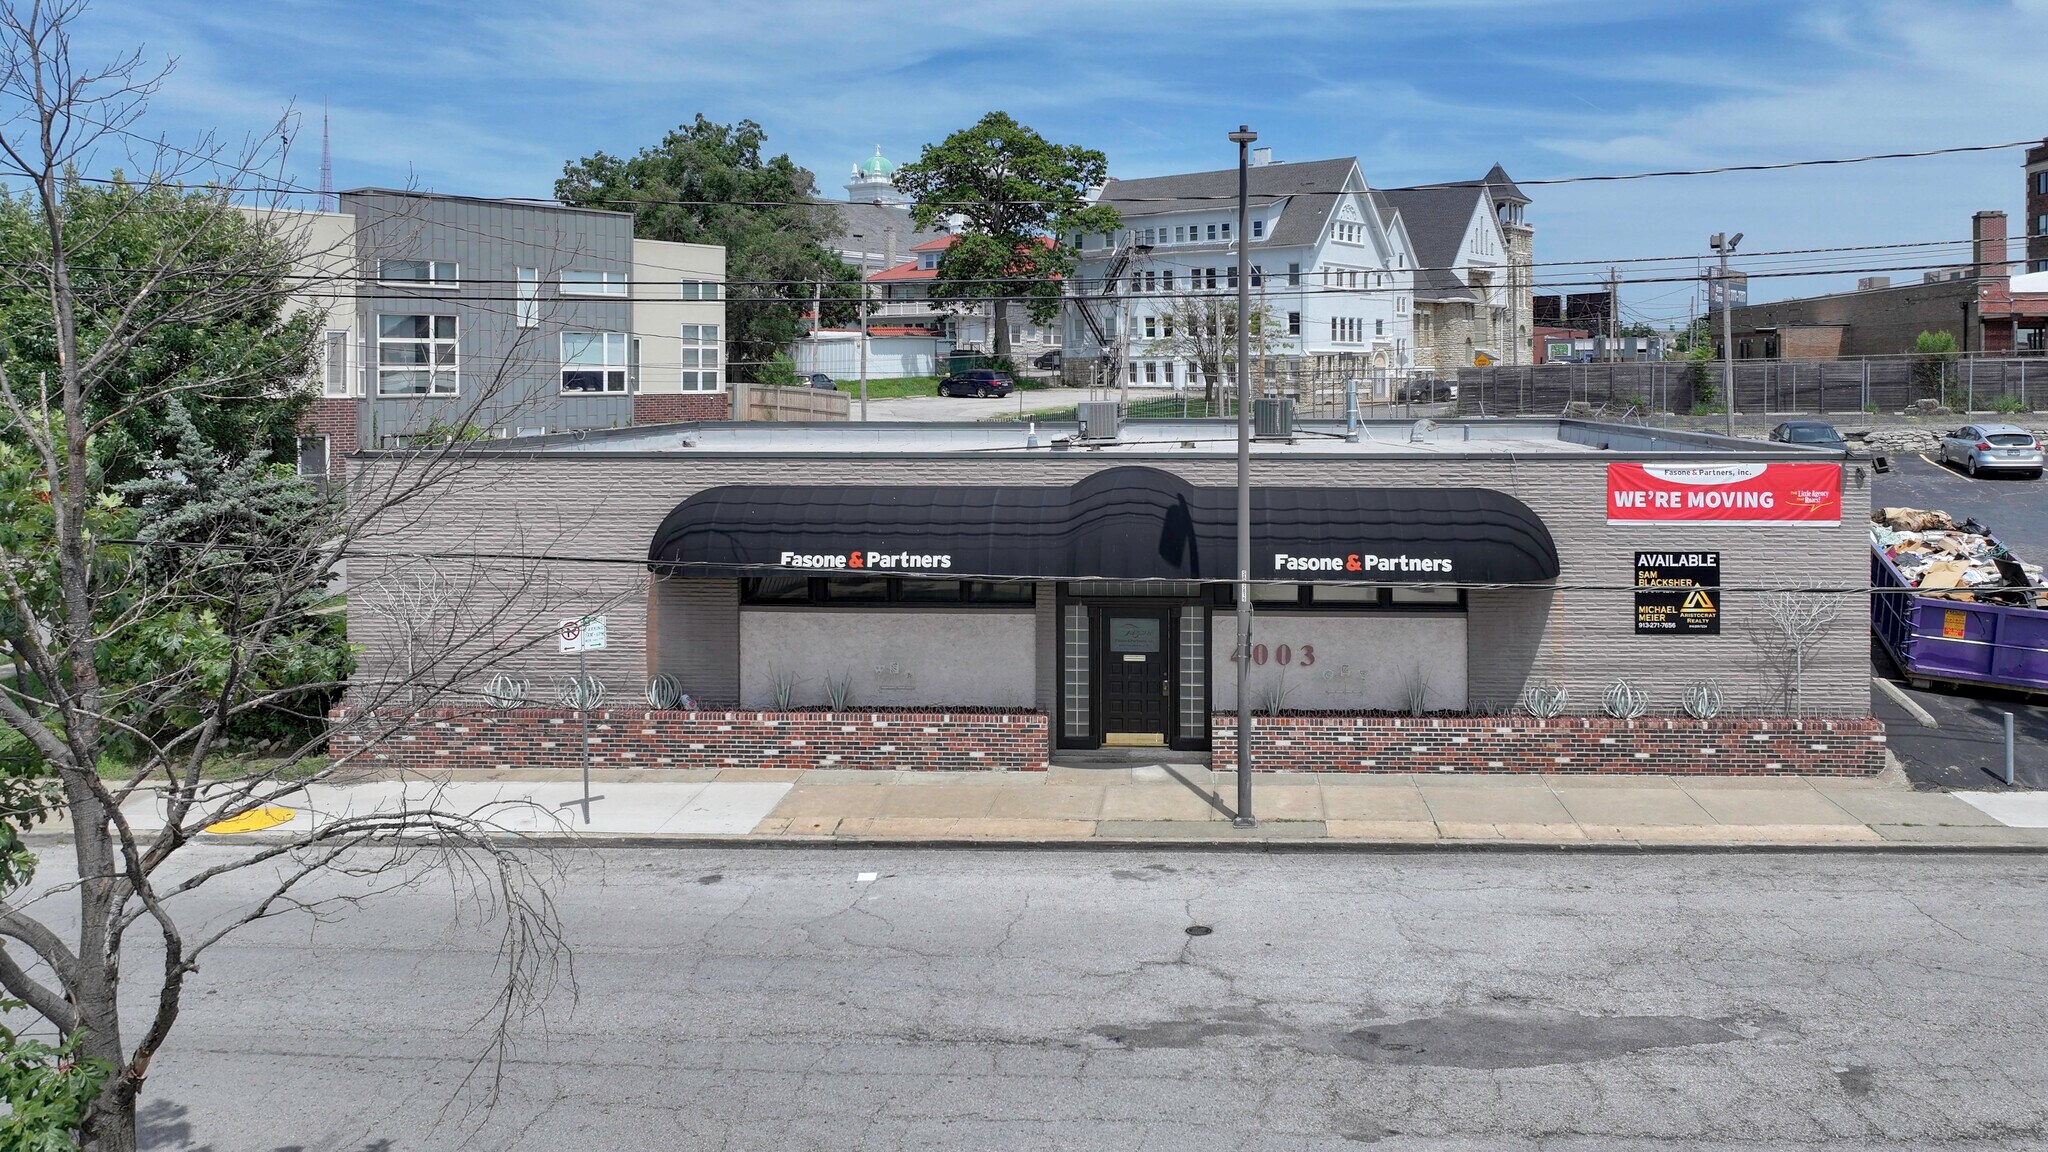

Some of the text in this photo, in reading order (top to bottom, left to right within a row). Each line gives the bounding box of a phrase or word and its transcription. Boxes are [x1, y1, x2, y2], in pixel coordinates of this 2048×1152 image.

[1699, 469, 1736, 477] Partners,
[1614, 491, 1774, 508] WE’RE MOVING
[1812, 490, 1829, 498] Agency
[781, 551, 951, 568] Fasone & Partners
[1275, 554, 1453, 572] Fasone & Partners
[1638, 554, 1716, 566] AVAILABLE
